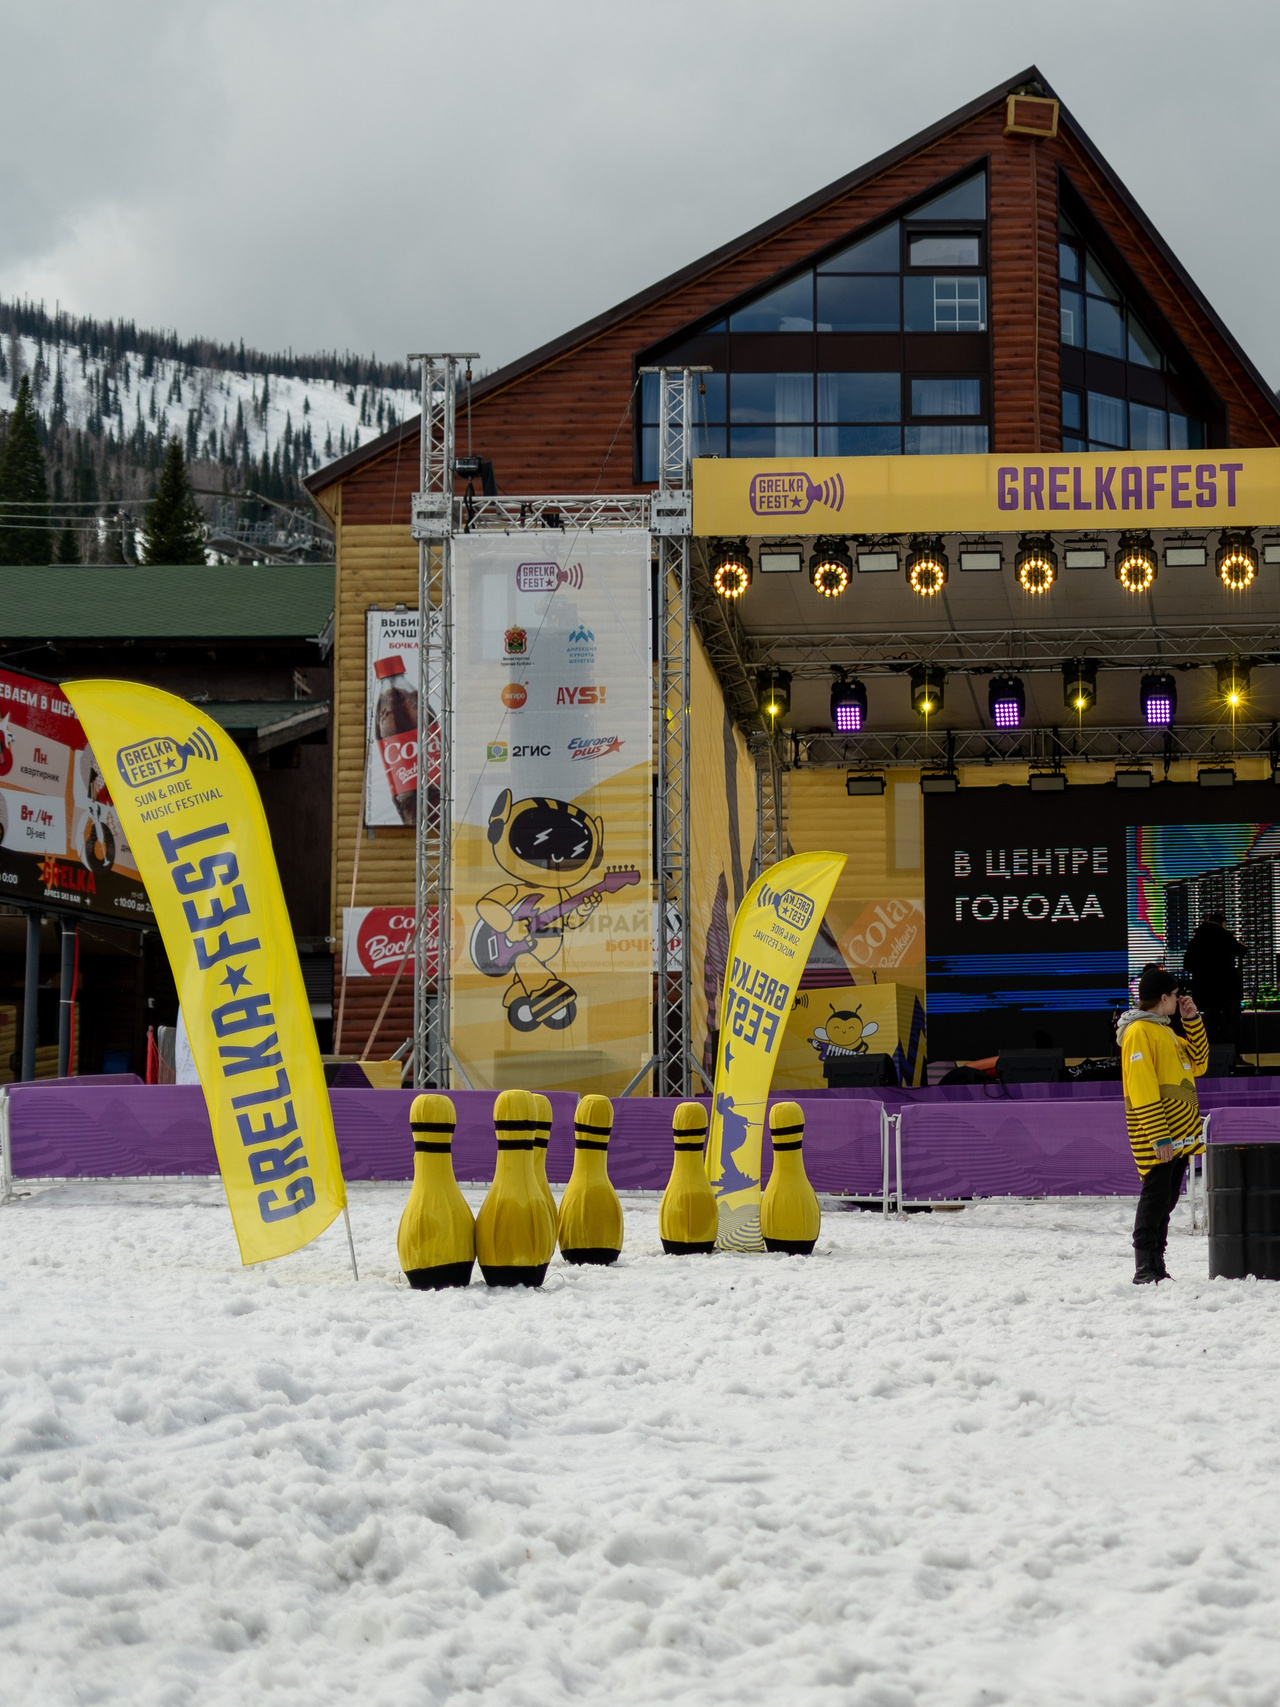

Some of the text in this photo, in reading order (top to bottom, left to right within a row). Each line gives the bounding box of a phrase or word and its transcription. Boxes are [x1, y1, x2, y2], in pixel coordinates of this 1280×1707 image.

[759, 478, 804, 493] GRELKA
[997, 463, 1244, 511] GRELKAFEST
[759, 495, 790, 509] FEST
[522, 566, 555, 577] GRELKA
[522, 578, 545, 588] FEST
[40, 695, 48, 710] В
[556, 685, 606, 705] AYS!
[124, 740, 174, 767] GRELKA
[512, 744, 552, 758] 2ГИС
[130, 759, 162, 782] FEST
[134, 779, 193, 808] SUN & RIDE
[140, 788, 223, 823] MUSIC FESTIVAL
[954, 847, 1109, 879] В ЦЕНТРЕ
[955, 891, 1105, 922] ГОРОДА
[156, 821, 316, 1225] GRELKA FEST
